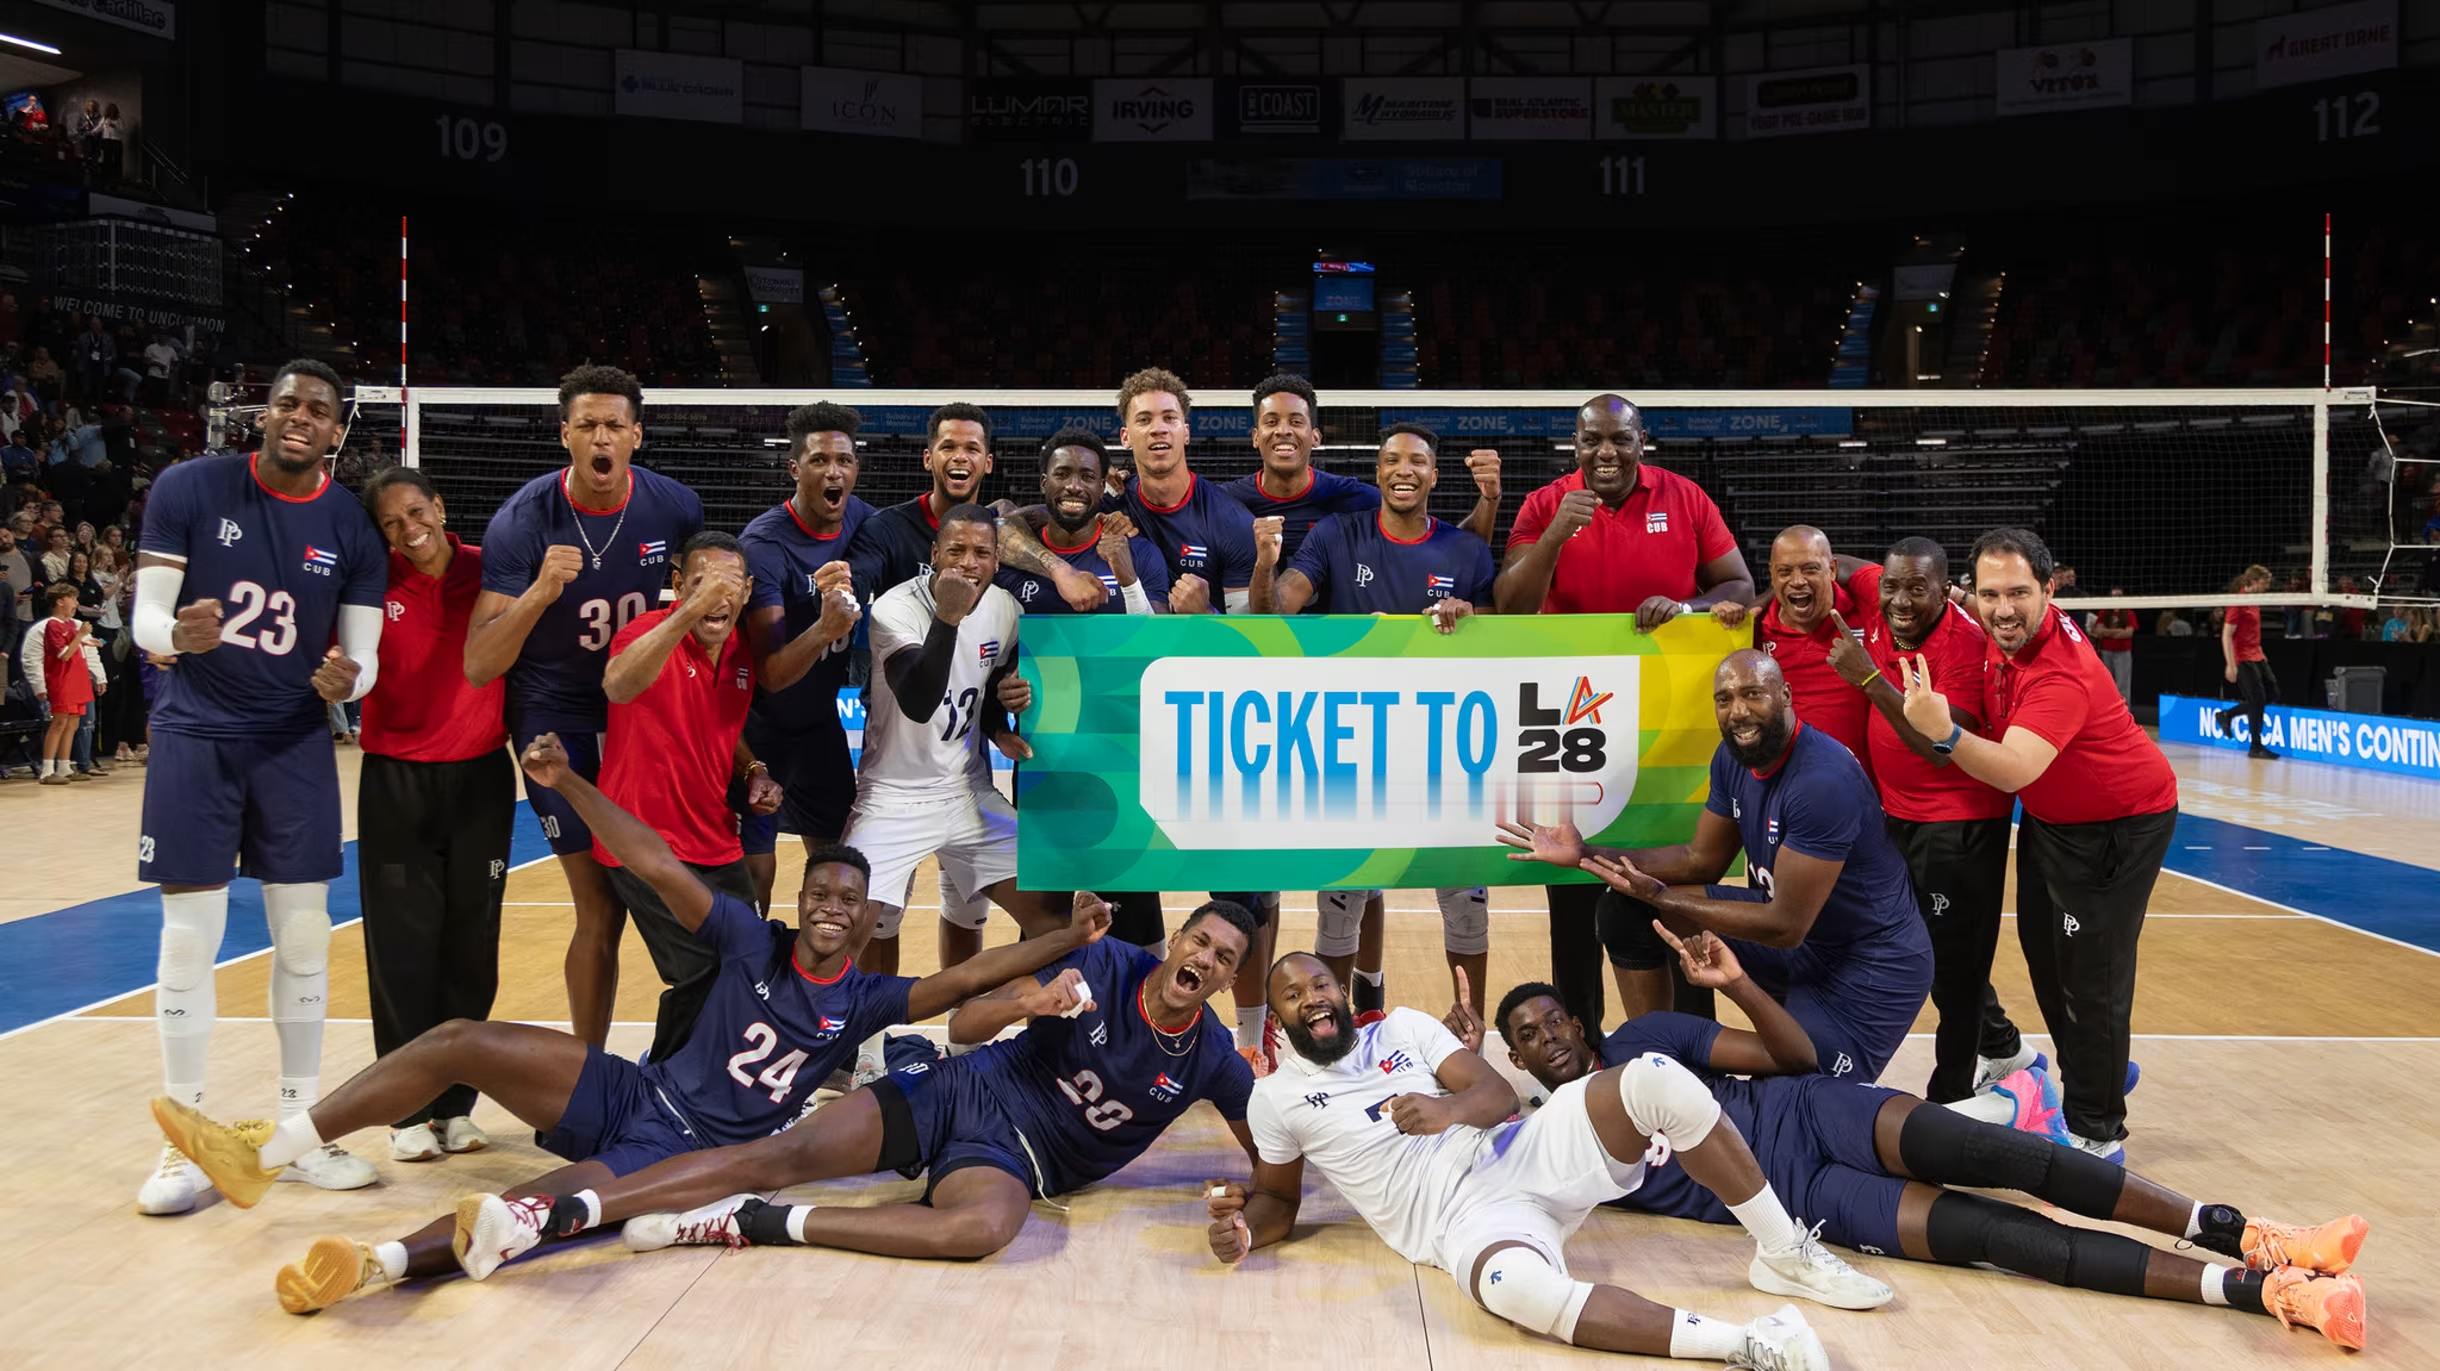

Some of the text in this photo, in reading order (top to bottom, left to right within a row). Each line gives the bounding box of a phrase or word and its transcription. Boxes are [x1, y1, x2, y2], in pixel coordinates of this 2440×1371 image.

[833, 100, 897, 121] ICON
[972, 95, 1089, 114] LUMAR
[1112, 100, 1195, 119] IRVING
[1260, 92, 1314, 116] COAST
[2312, 91, 2381, 141] 112
[435, 114, 507, 162] 109
[1020, 157, 1079, 196] 110
[1600, 156, 1646, 194] 111
[54, 295, 124, 319] WELCOME
[128, 306, 145, 320] TO
[1062, 416, 1112, 431] ZONE
[1198, 416, 1248, 430] ZONE
[1457, 416, 1508, 431] ZONE
[1731, 415, 1781, 431] ZONE
[1646, 522, 1668, 534] CUB
[303, 562, 331, 576] CUB
[640, 554, 664, 567] CUB
[1180, 559, 1204, 568] CUB
[1427, 588, 1451, 599] CUB
[220, 579, 298, 656] 23
[1518, 675, 1614, 727] LA
[1164, 689, 1498, 775] TICKET TO
[2199, 706, 2286, 748] NOCCA
[2290, 716, 2351, 757] MEN'S
[1517, 727, 1607, 774] 28
[139, 835, 156, 863] 23
[727, 1021, 810, 1104] 24
[1149, 1086, 1173, 1104] CUB
